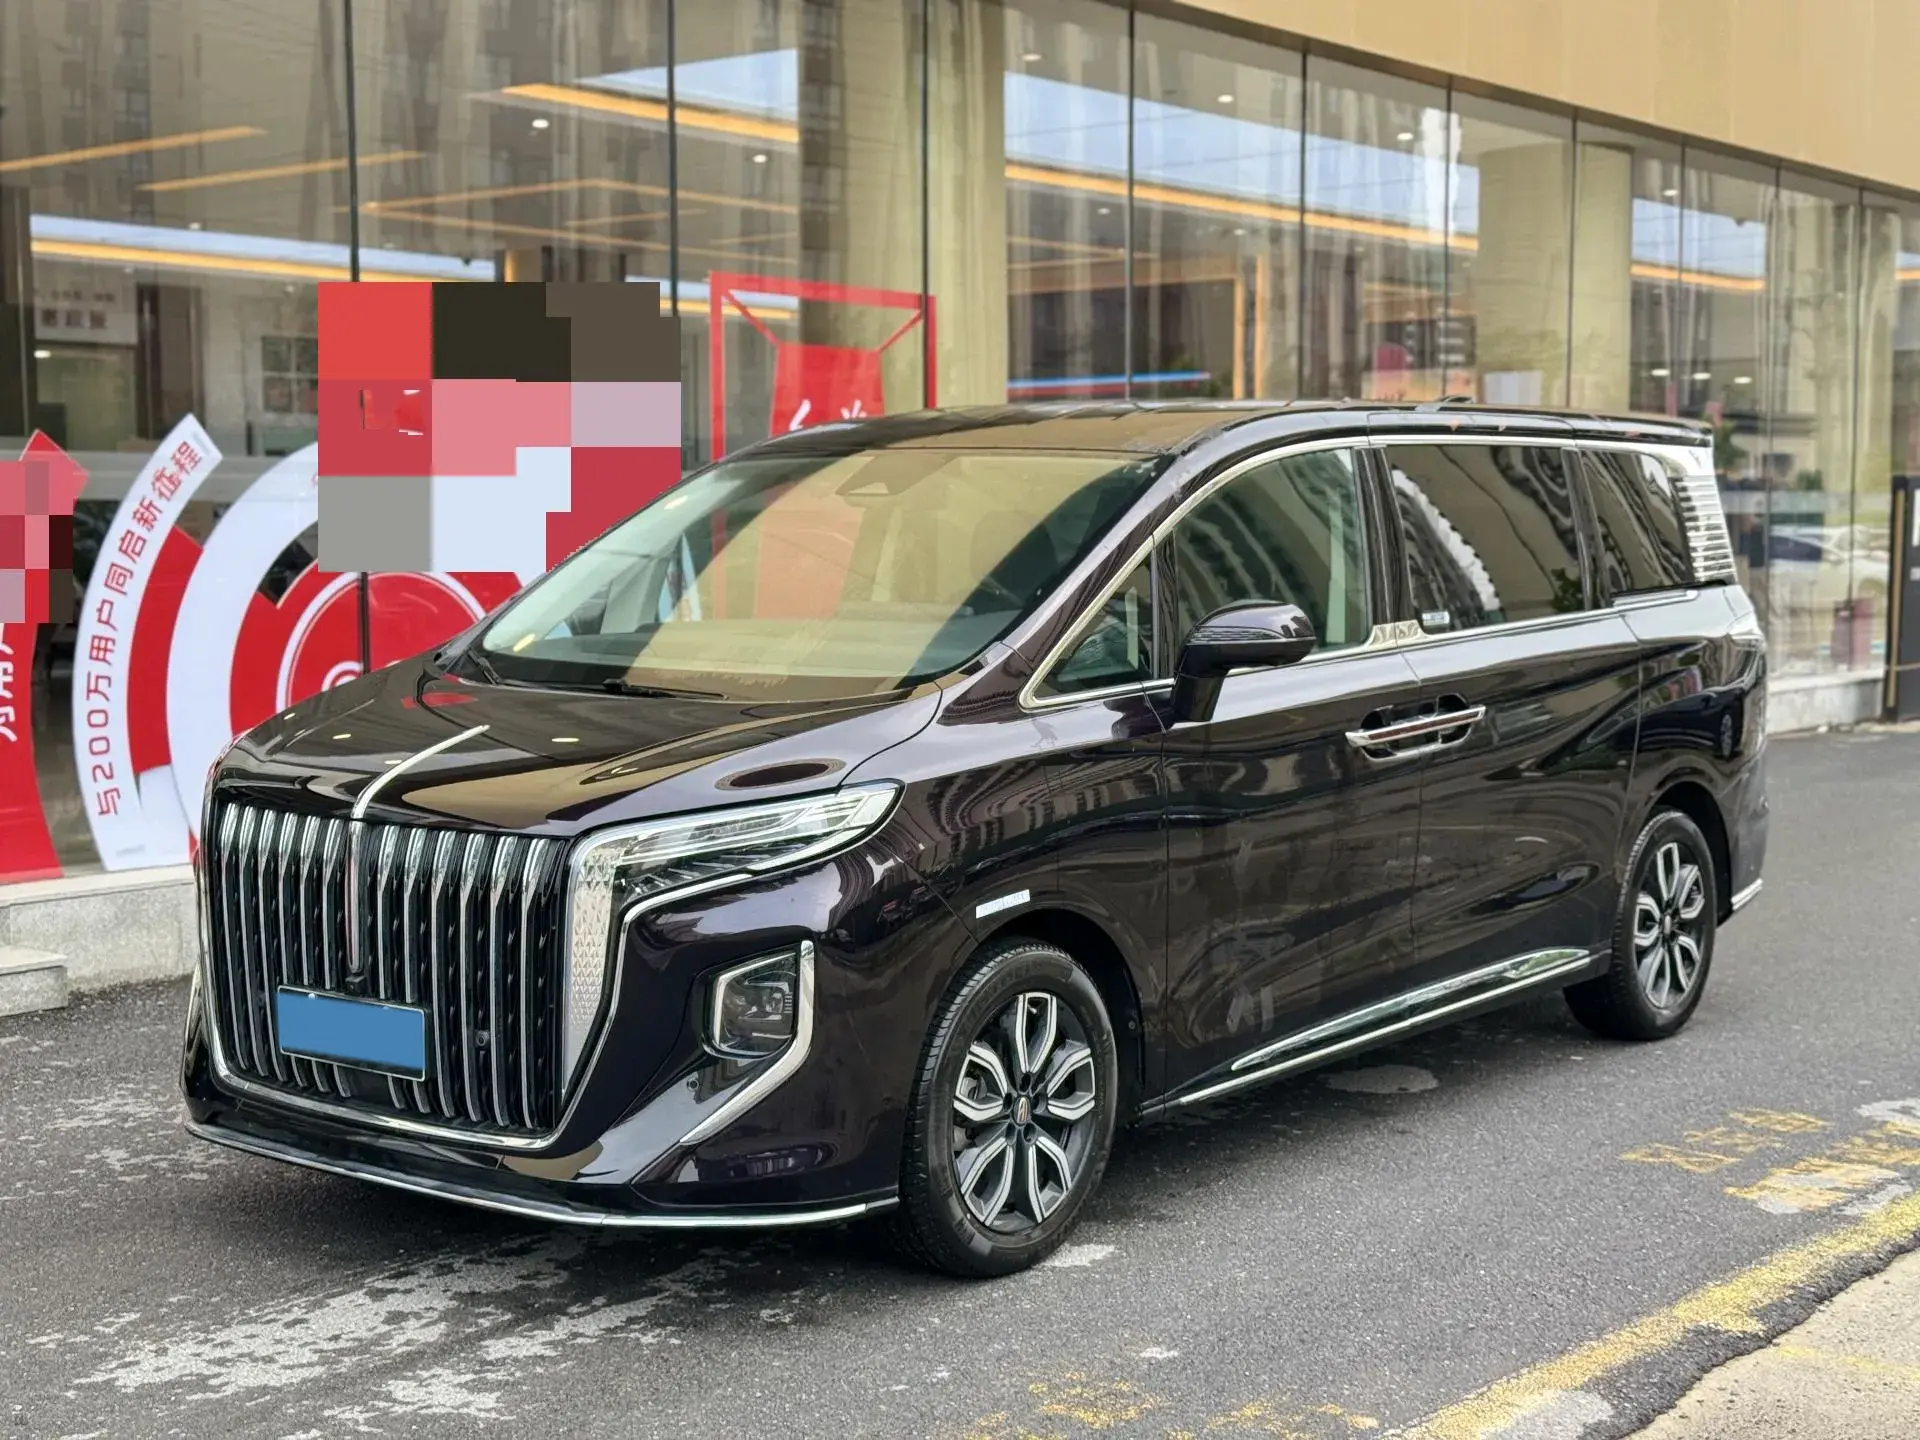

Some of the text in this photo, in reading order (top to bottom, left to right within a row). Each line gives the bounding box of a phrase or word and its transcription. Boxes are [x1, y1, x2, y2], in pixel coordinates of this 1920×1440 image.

[86, 441, 201, 816] 与200万用户同启新征程
